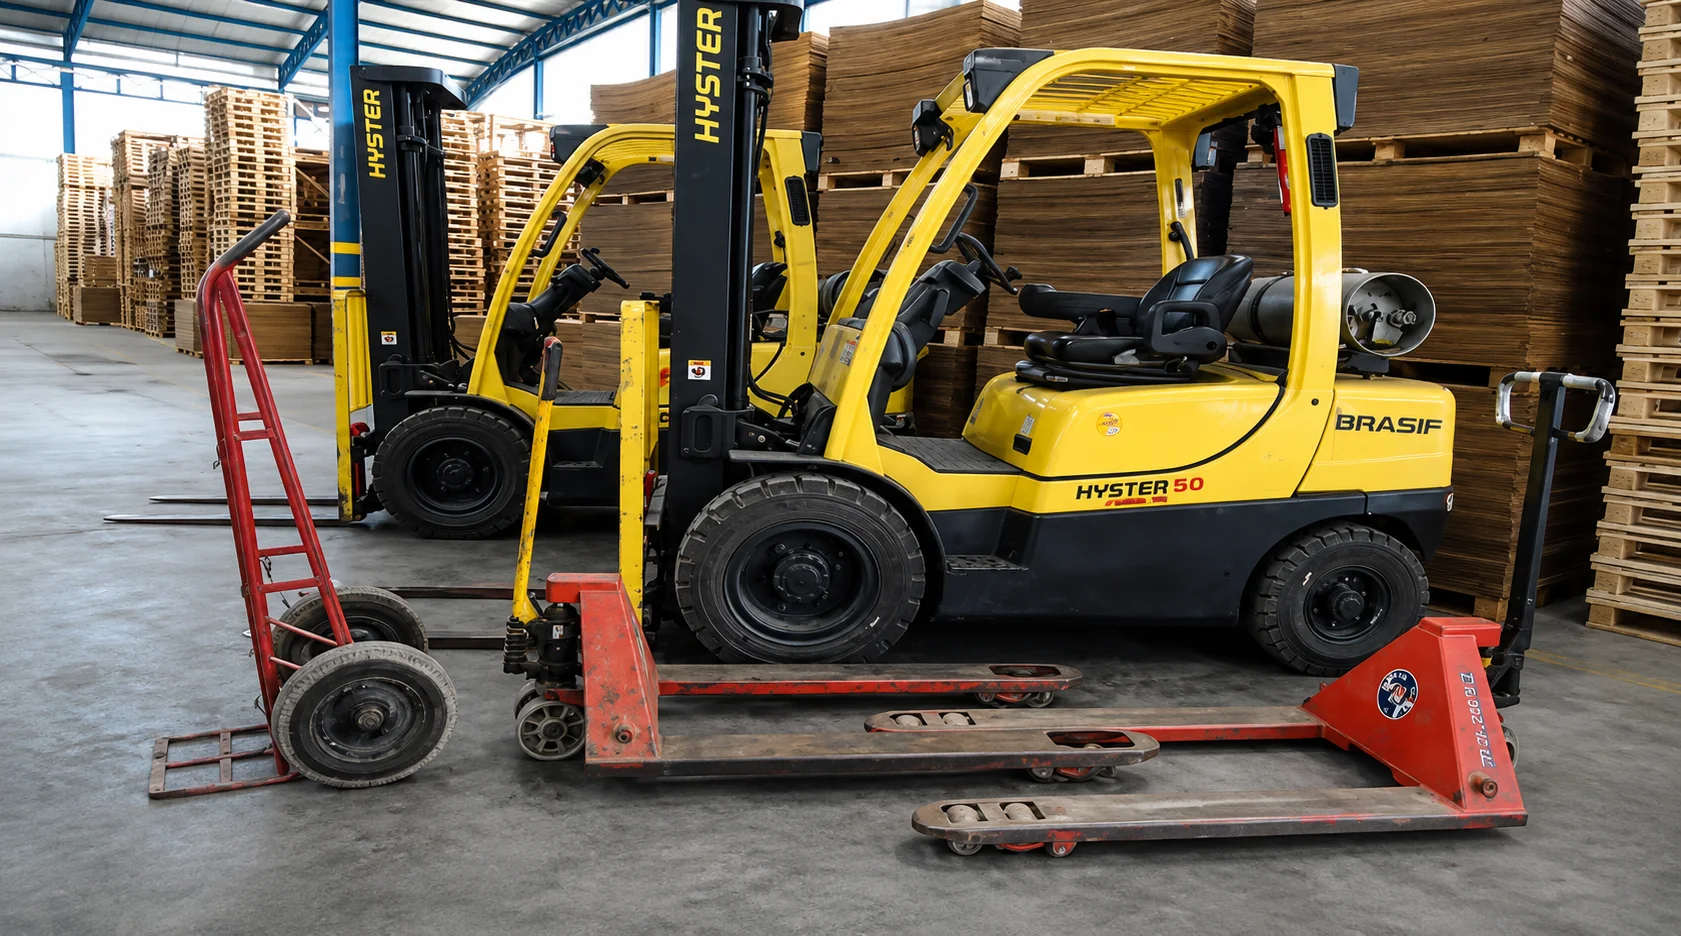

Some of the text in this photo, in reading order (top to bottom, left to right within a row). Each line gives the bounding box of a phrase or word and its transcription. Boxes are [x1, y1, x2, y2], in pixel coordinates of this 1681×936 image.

[694, 7, 722, 144] HYSTER
[363, 89, 386, 178] HYSTER
[1335, 414, 1443, 435] BRASIF
[1075, 477, 1204, 500] HYSTER 50
